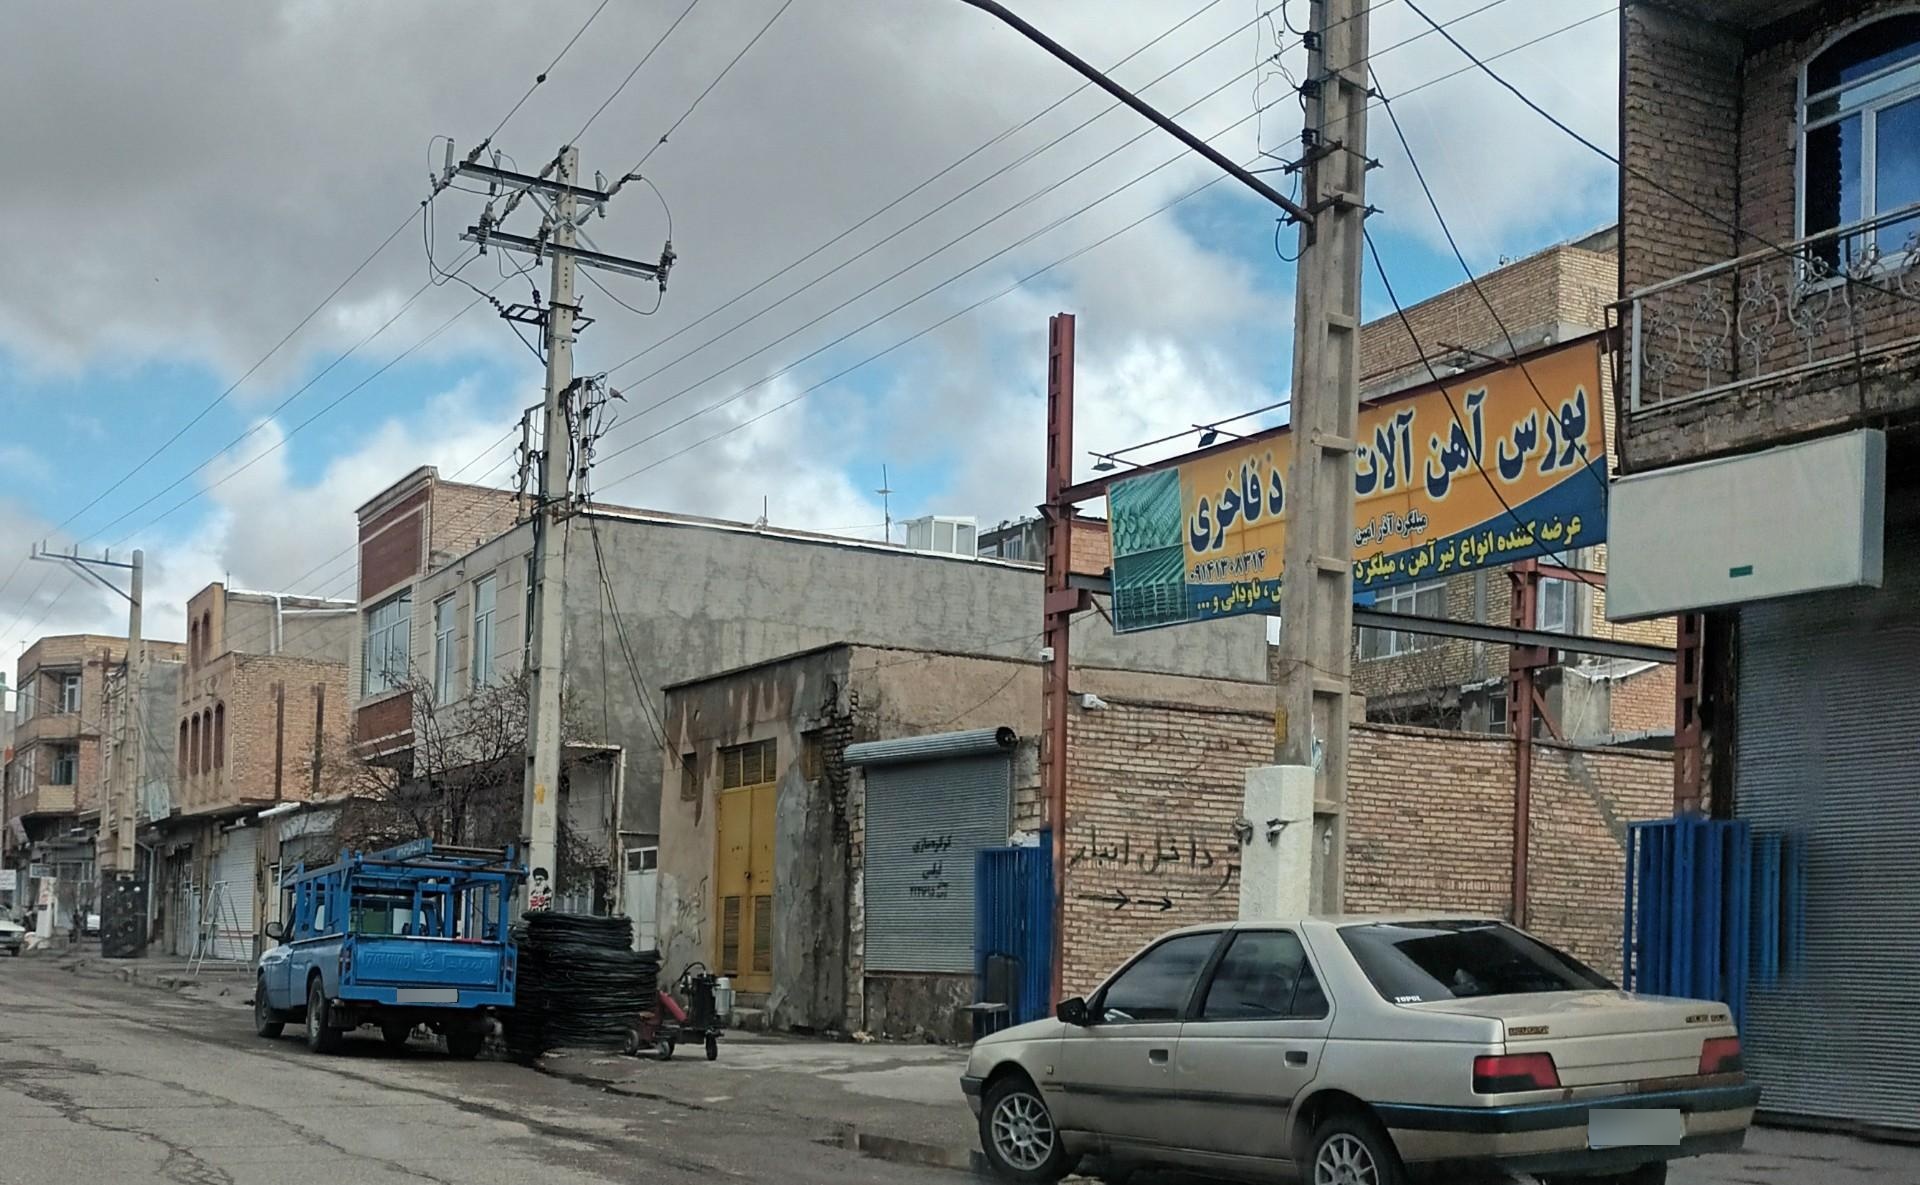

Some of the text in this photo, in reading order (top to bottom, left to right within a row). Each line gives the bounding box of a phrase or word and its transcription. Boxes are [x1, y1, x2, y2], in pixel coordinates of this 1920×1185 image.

[1355, 409, 1414, 495] آلات
[1426, 388, 1486, 498] آهن
[1498, 388, 1587, 481] بورس
[1190, 457, 1262, 553] فاخری
[1497, 520, 1536, 551] کننده
[1541, 515, 1582, 546] عرضه
[1437, 539, 1456, 573] تیر
[1459, 530, 1494, 567] انواع
